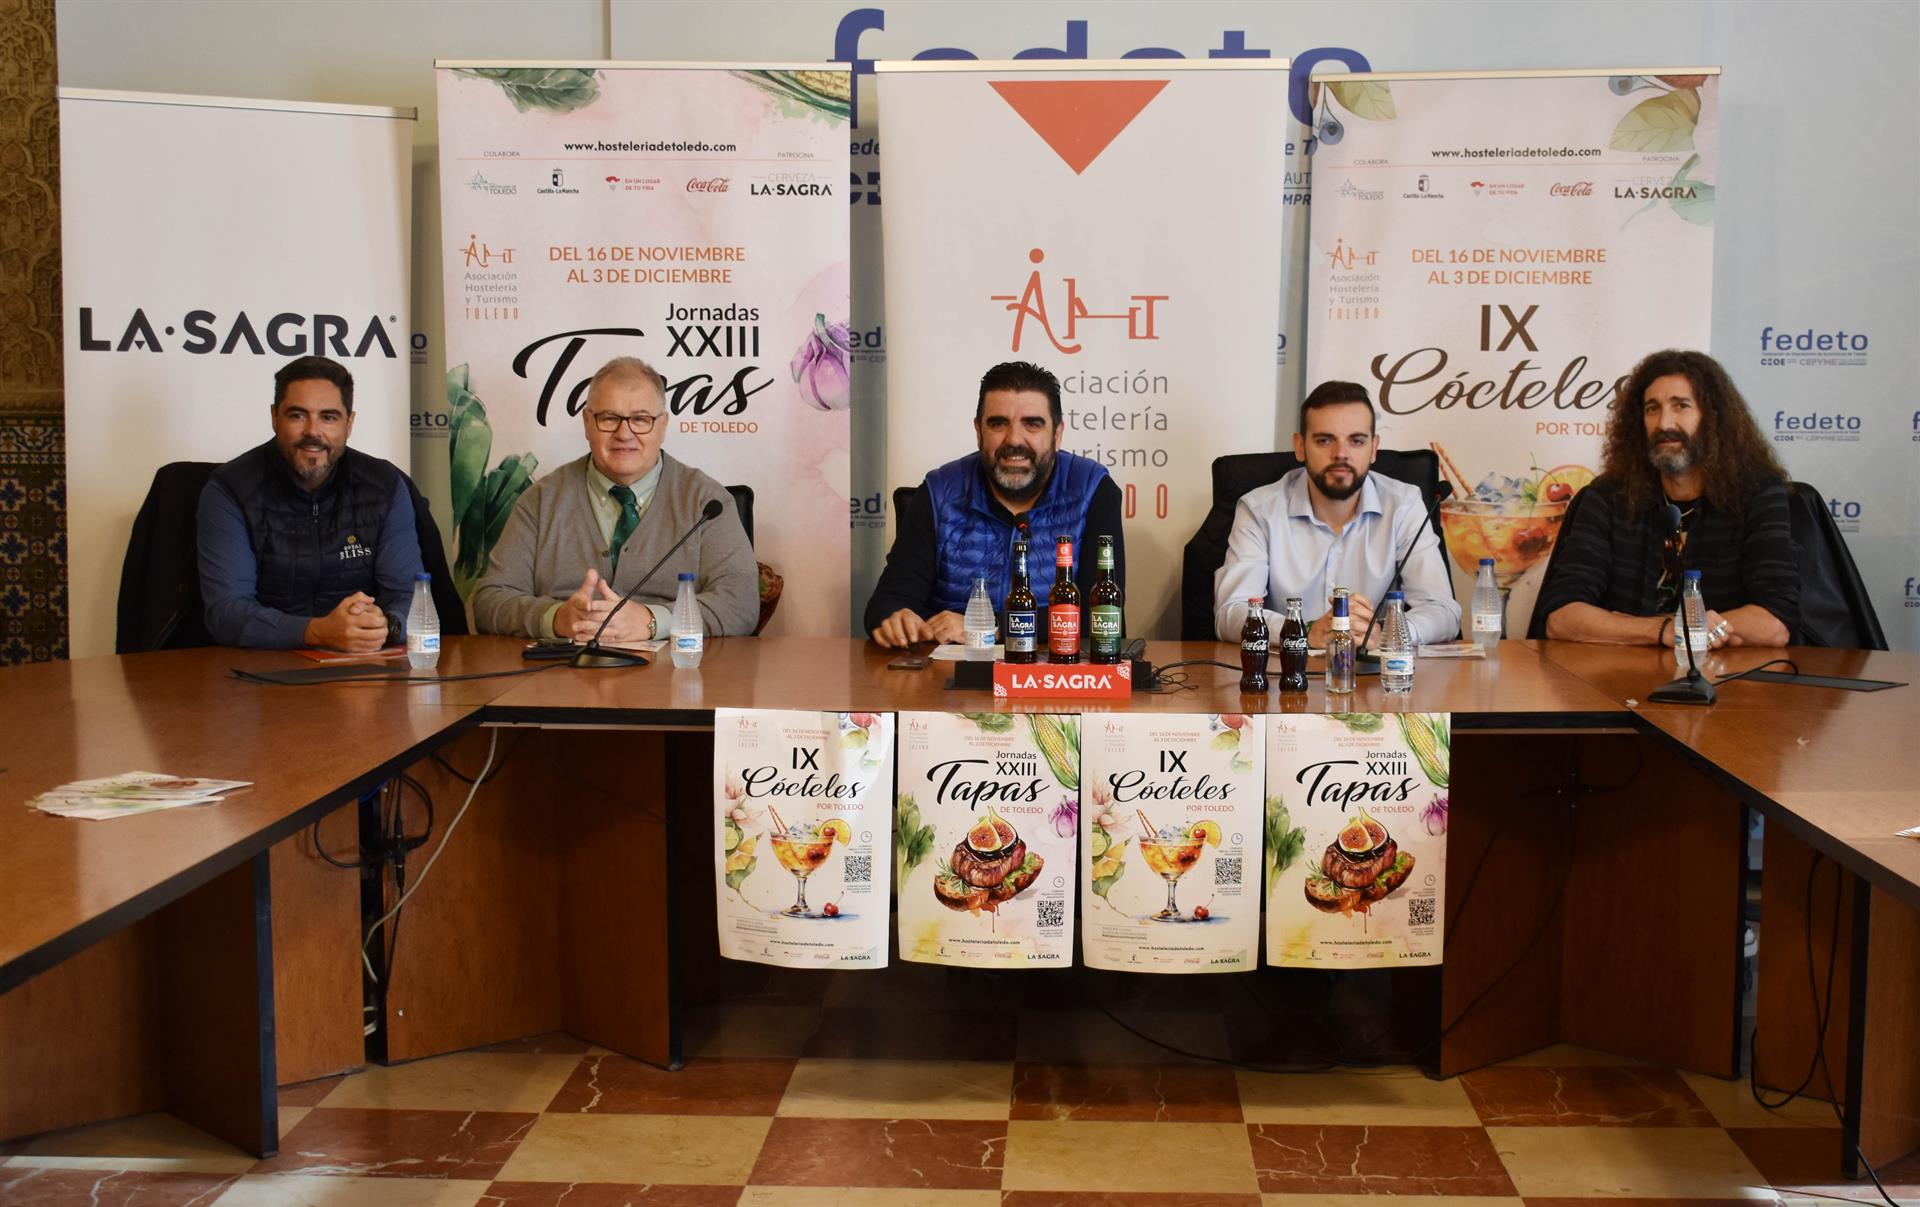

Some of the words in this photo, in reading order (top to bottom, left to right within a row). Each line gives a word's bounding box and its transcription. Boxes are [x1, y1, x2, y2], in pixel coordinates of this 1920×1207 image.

[565, 141, 736, 151] www.hosteleriadetoledo.com
[1432, 147, 1601, 157] www.hosteleriadetoledo.com
[484, 151, 520, 159] COLABORA
[776, 152, 814, 161] PATROCINA
[1643, 156, 1681, 164] PATROCINA
[1354, 159, 1388, 167] COLABORA
[767, 172, 816, 183] CERVEZA
[550, 247, 582, 261] DEL
[588, 247, 606, 261] 16
[612, 247, 634, 261] DE
[639, 247, 744, 261] NOVIEMBRE
[1412, 249, 1444, 263] DEL
[1450, 250, 1468, 263] 16
[1473, 249, 1495, 263] DE
[1500, 249, 1606, 263] NOVIEMBRE
[464, 272, 517, 280] Asociación
[567, 269, 589, 283] AL
[593, 269, 602, 283] 3
[608, 269, 629, 283] DE
[635, 269, 731, 283] DICIEMBRE
[1329, 272, 1379, 282] Asociación
[1428, 271, 1449, 284] AL
[1454, 271, 1463, 284] 3
[1468, 271, 1490, 284] DE
[1495, 271, 1592, 284] DICIEMBRE
[476, 295, 517, 304] Turismo
[1340, 296, 1379, 304] Turismo
[466, 308, 518, 320] TOLEDO
[666, 303, 759, 321] Jornadas
[1481, 305, 1539, 351] IX
[667, 326, 759, 357] XXIII
[1761, 327, 1868, 350] fedeto
[512, 328, 774, 427] Tas
[1063, 369, 1168, 394] ciación
[1068, 405, 1168, 430] telería
[1774, 411, 1861, 430] fedeto
[680, 422, 698, 433] DE
[702, 422, 758, 433] TOLEDO
[1536, 422, 1568, 435] POR
[340, 547, 371, 560] BLISS
[793, 748, 819, 770] IX
[996, 751, 1036, 759] Jornadas
[1366, 750, 1407, 758] Jornadas
[1161, 751, 1187, 772] IX
[996, 762, 1036, 776] XXIII
[1367, 762, 1406, 775] XXIII
[742, 766, 864, 799] Cócteles
[927, 758, 1051, 811] Tapas
[1109, 770, 1236, 802] Cócteles
[1296, 758, 1422, 812] Tapas
[834, 803, 864, 811] TOLEDO
